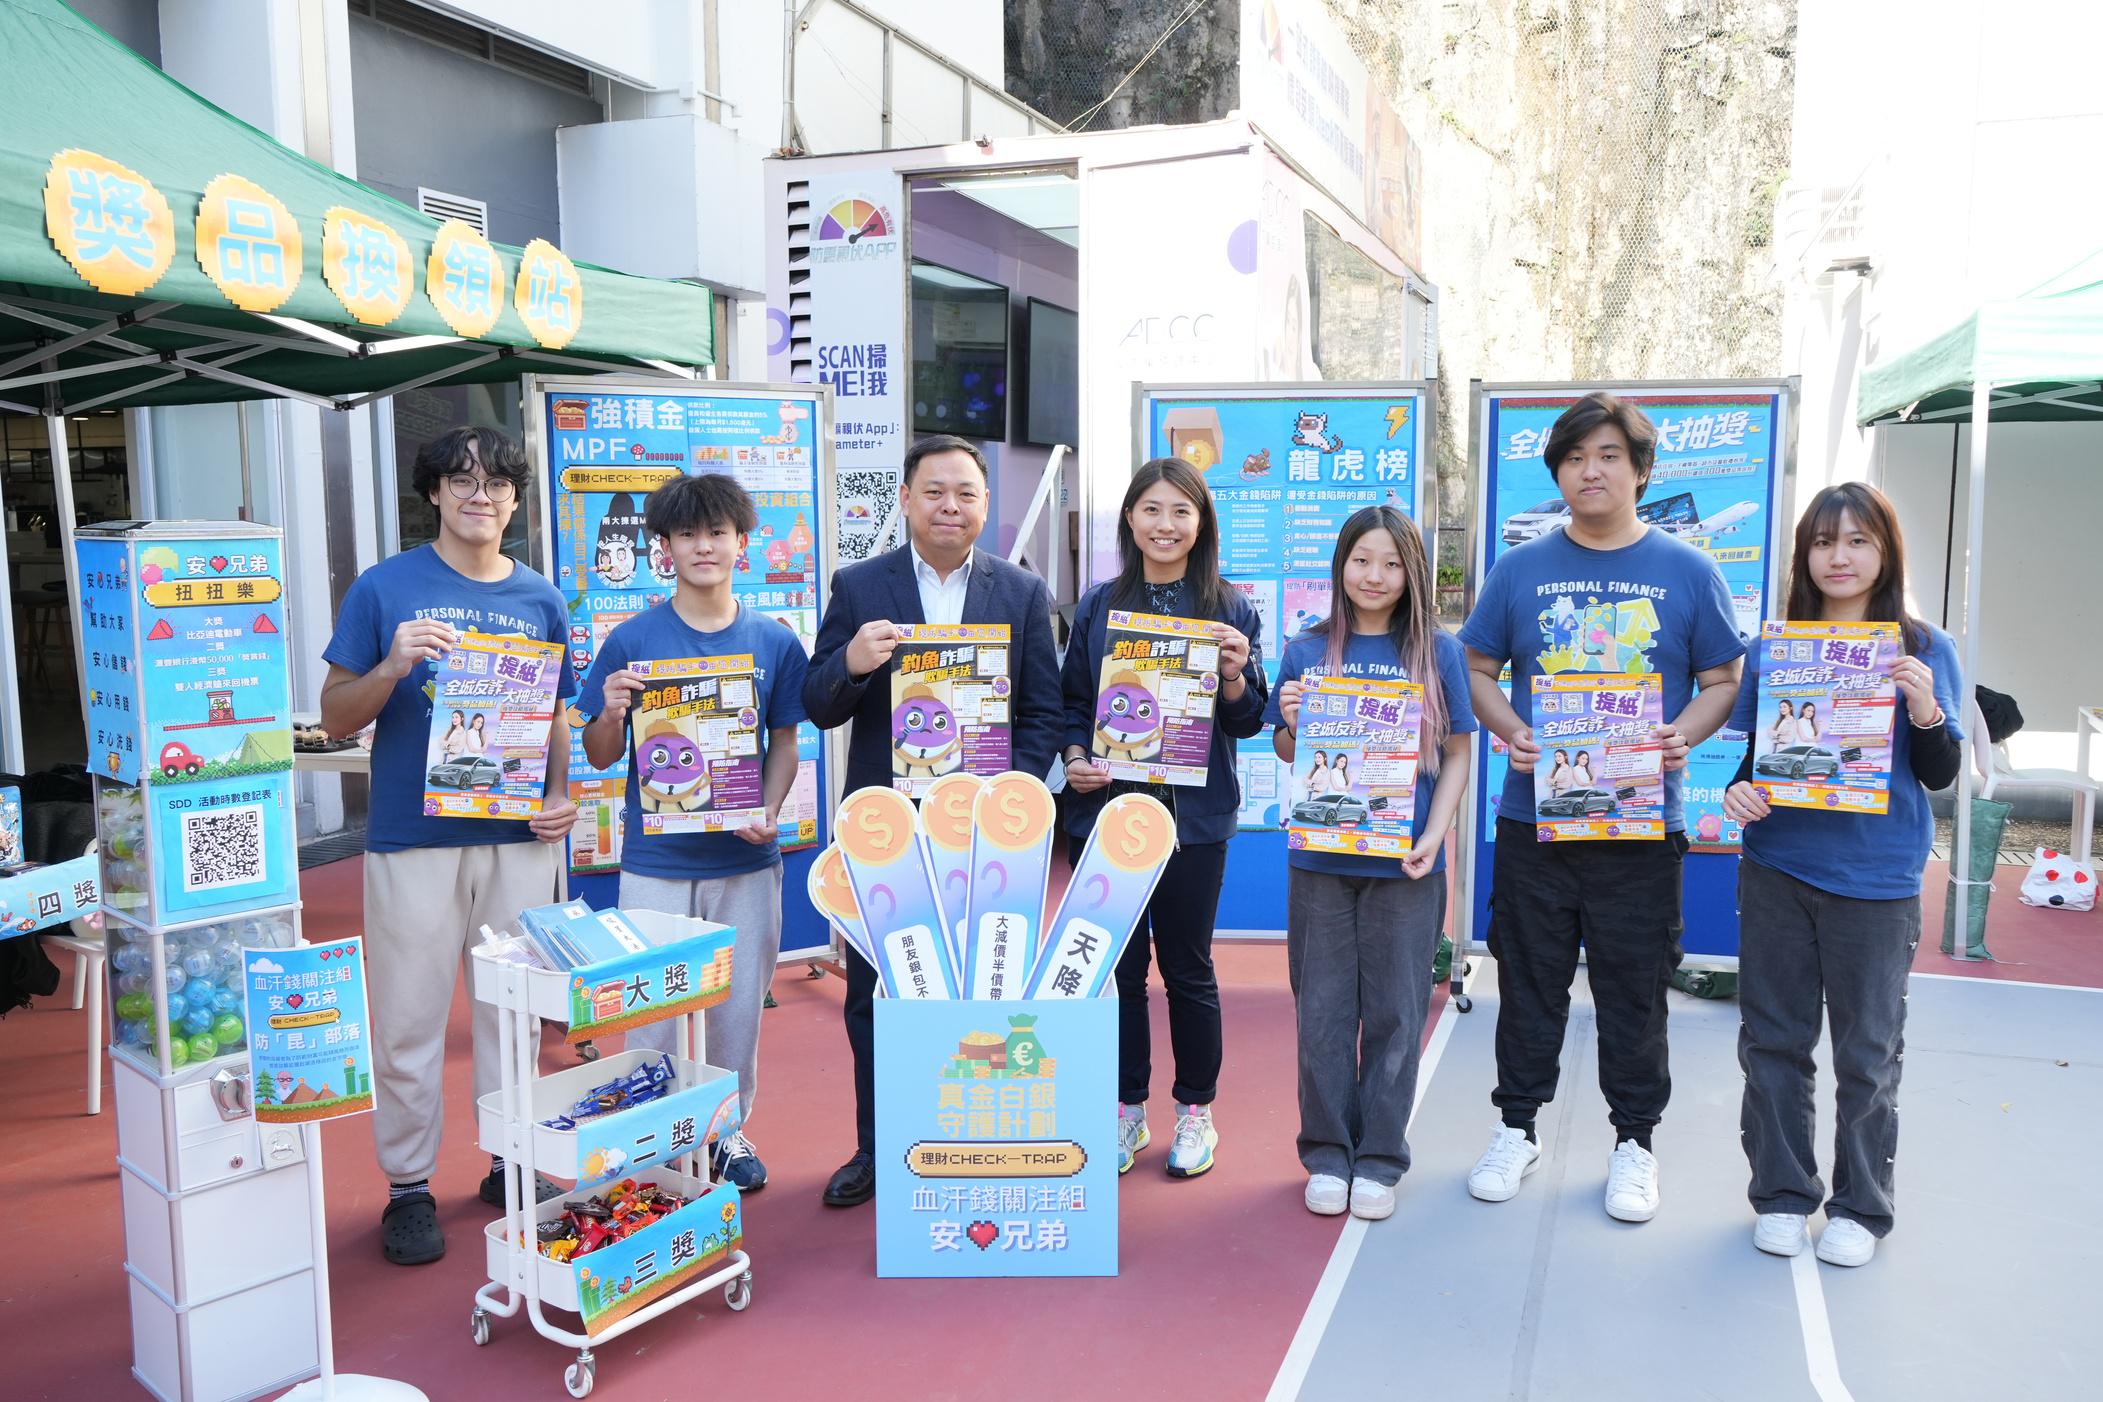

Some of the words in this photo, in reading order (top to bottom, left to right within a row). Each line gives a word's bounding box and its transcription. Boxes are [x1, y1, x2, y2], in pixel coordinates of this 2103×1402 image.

[66, 166, 572, 329] 獎品換領站
[818, 345, 864, 369] SCAN
[591, 397, 685, 430] 強積金
[1655, 411, 1752, 453] 大抽獎
[562, 438, 627, 460] MPF
[1288, 449, 1408, 482] 龍虎榜
[175, 583, 255, 602] 扭扭樂
[585, 594, 644, 611] 100法則
[1536, 580, 1603, 597] PERSONAL
[1607, 581, 1667, 600] FINANCE
[204, 616, 224, 626] 大獎
[415, 607, 483, 622] PERSONAL
[488, 612, 539, 638] FINANCE
[206, 641, 225, 651] 二獎
[1112, 638, 1189, 660] 釣魚詐騙
[207, 667, 227, 677] 三獎
[901, 645, 976, 675] 釣魚詐騙
[642, 677, 718, 713] 釣魚詐騙
[169, 798, 192, 810] SDD
[198, 789, 272, 808] 活動時數登記表
[800, 828, 814, 837] UP
[37, 880, 98, 919] 四獎
[901, 935, 929, 999] 朋友銀包不
[1052, 931, 1099, 998] 天降
[254, 966, 353, 991] 血汗錢關注組
[626, 963, 689, 1009] 大獎
[937, 1083, 1056, 1110] 真金白銀
[937, 1111, 1056, 1138] 守護計劃
[632, 1118, 695, 1165] 二獎
[911, 1185, 1087, 1212] 血汗錢關注組
[634, 1230, 695, 1286] 三獎
